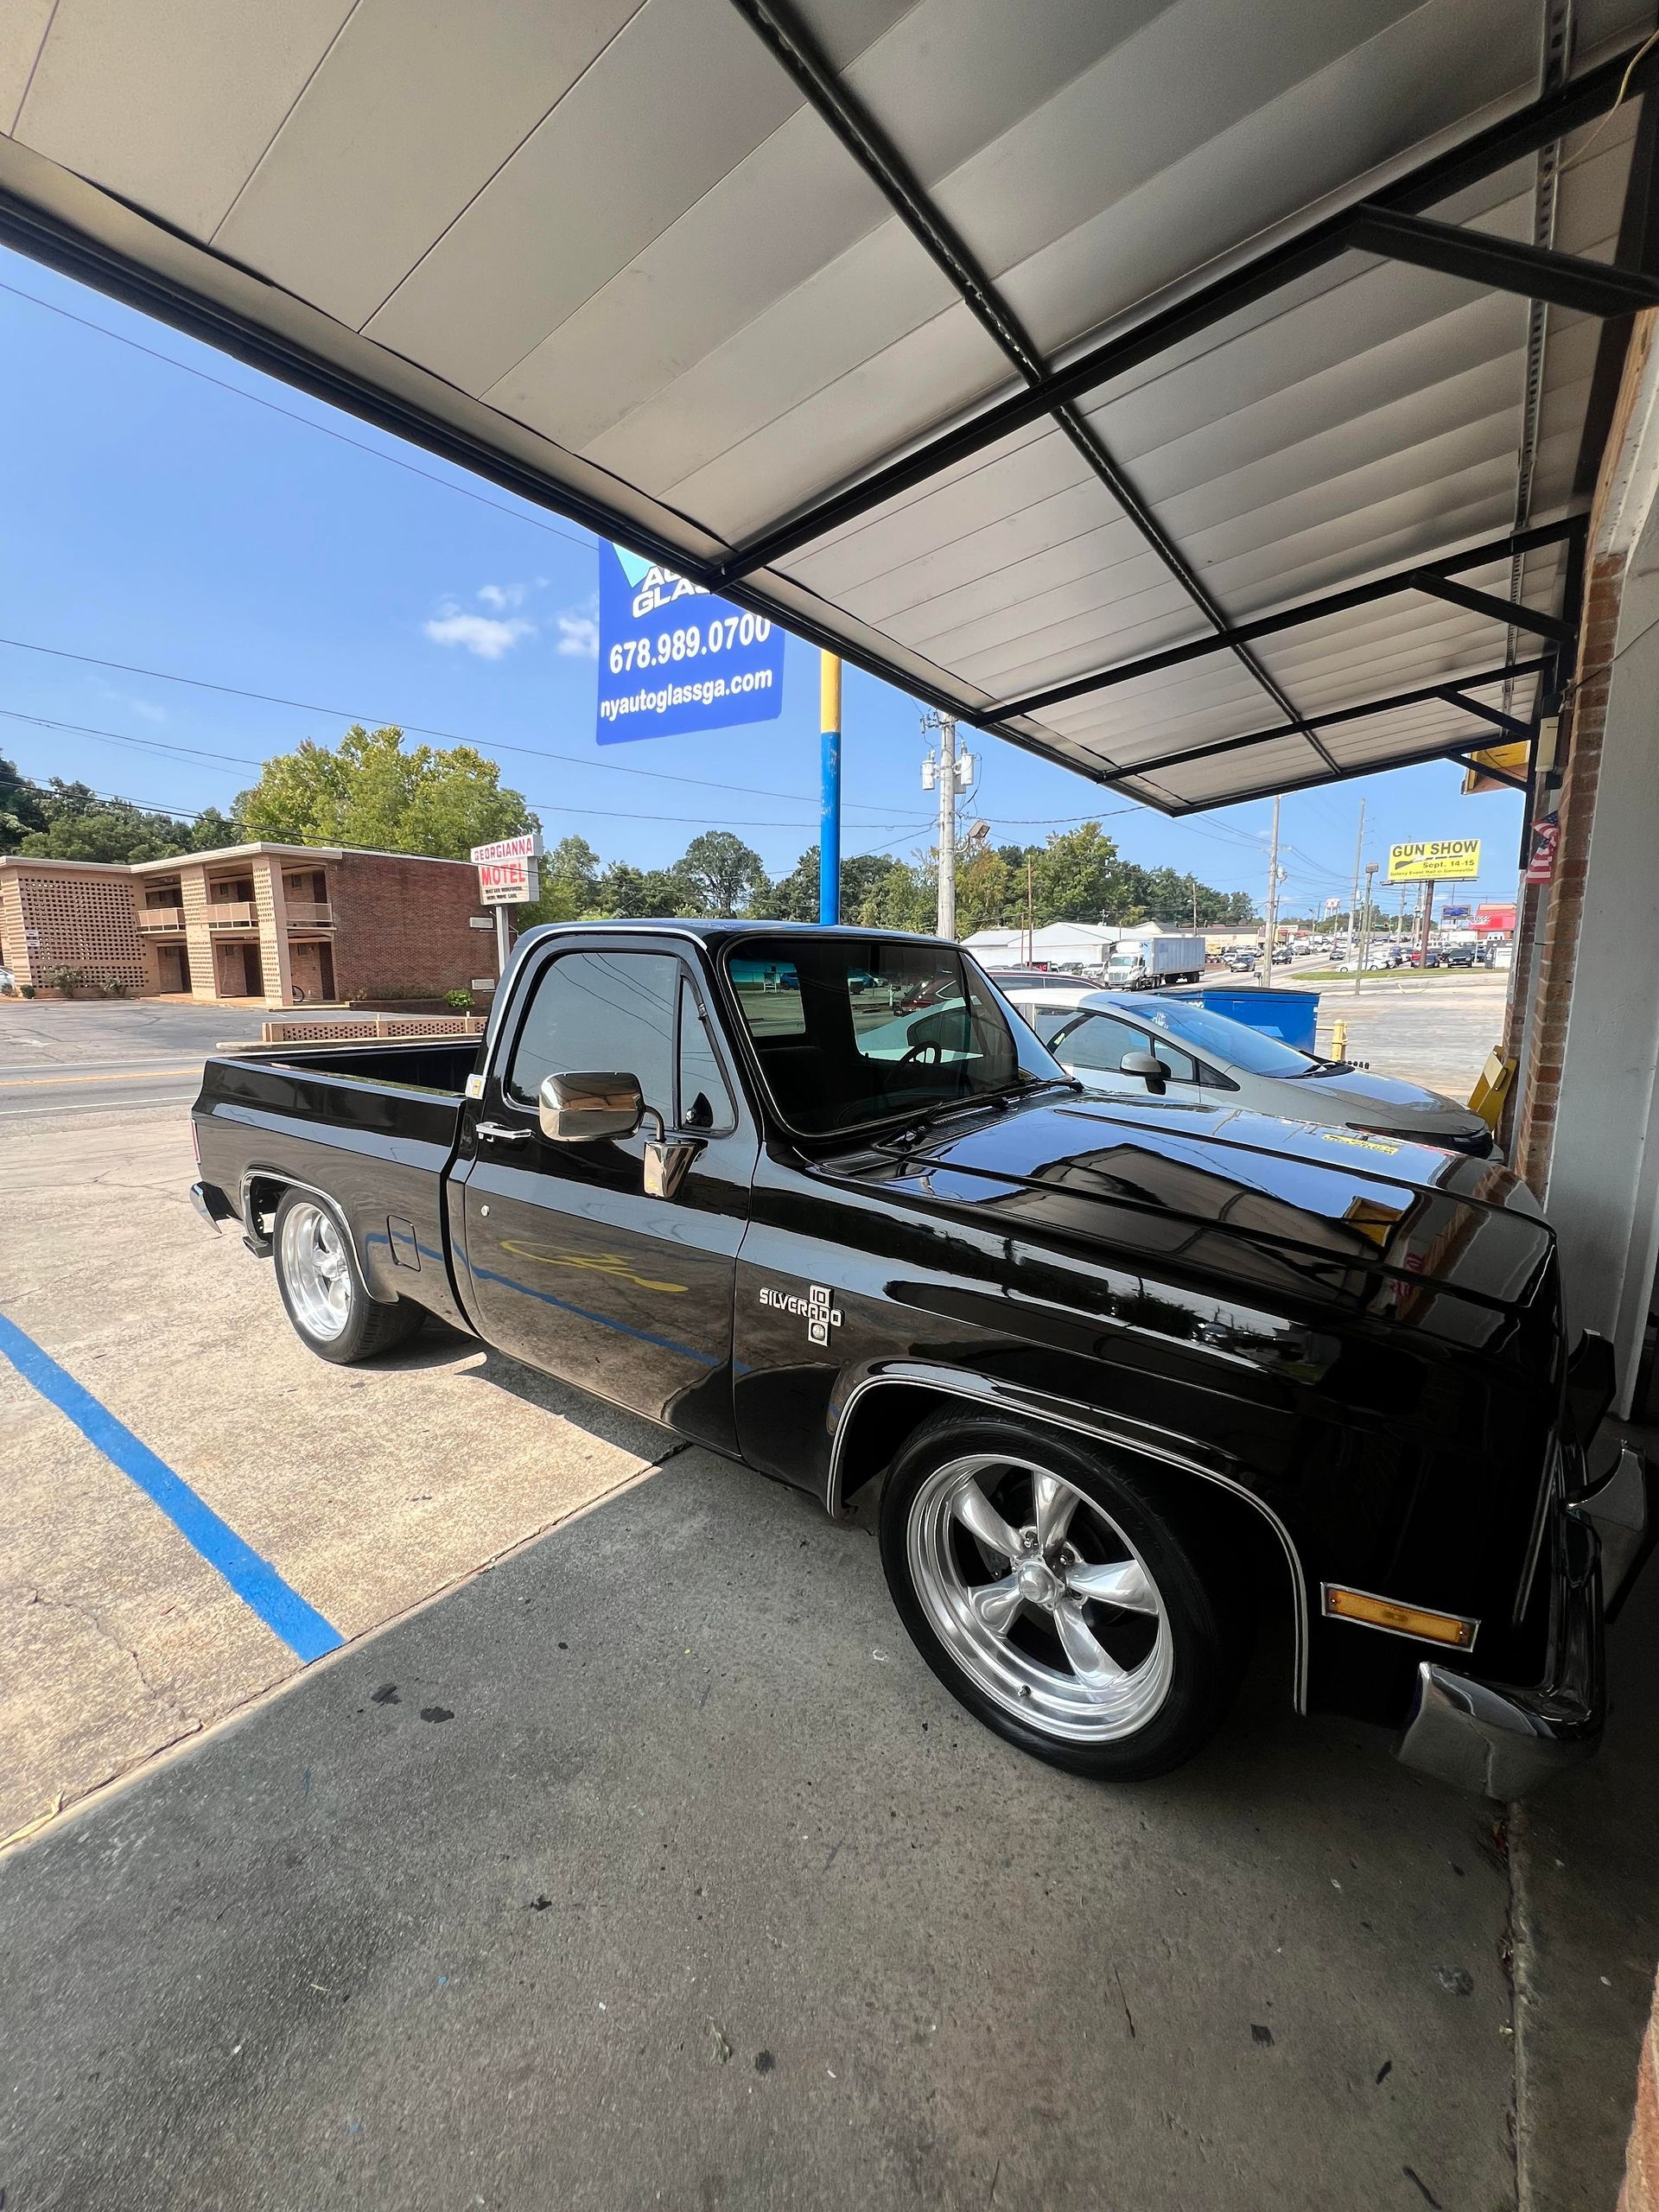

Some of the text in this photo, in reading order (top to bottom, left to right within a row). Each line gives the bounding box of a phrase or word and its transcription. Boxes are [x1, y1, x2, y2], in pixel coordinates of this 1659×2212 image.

[609, 613, 771, 674] 678.989.0700
[601, 668, 773, 721] nyautoglassga.com
[474, 837, 532, 861] GEORGIANNA
[1392, 840, 1478, 857] GUN SHOW
[481, 862, 526, 887] MOTEL
[759, 1287, 844, 1327] SILVERADO
